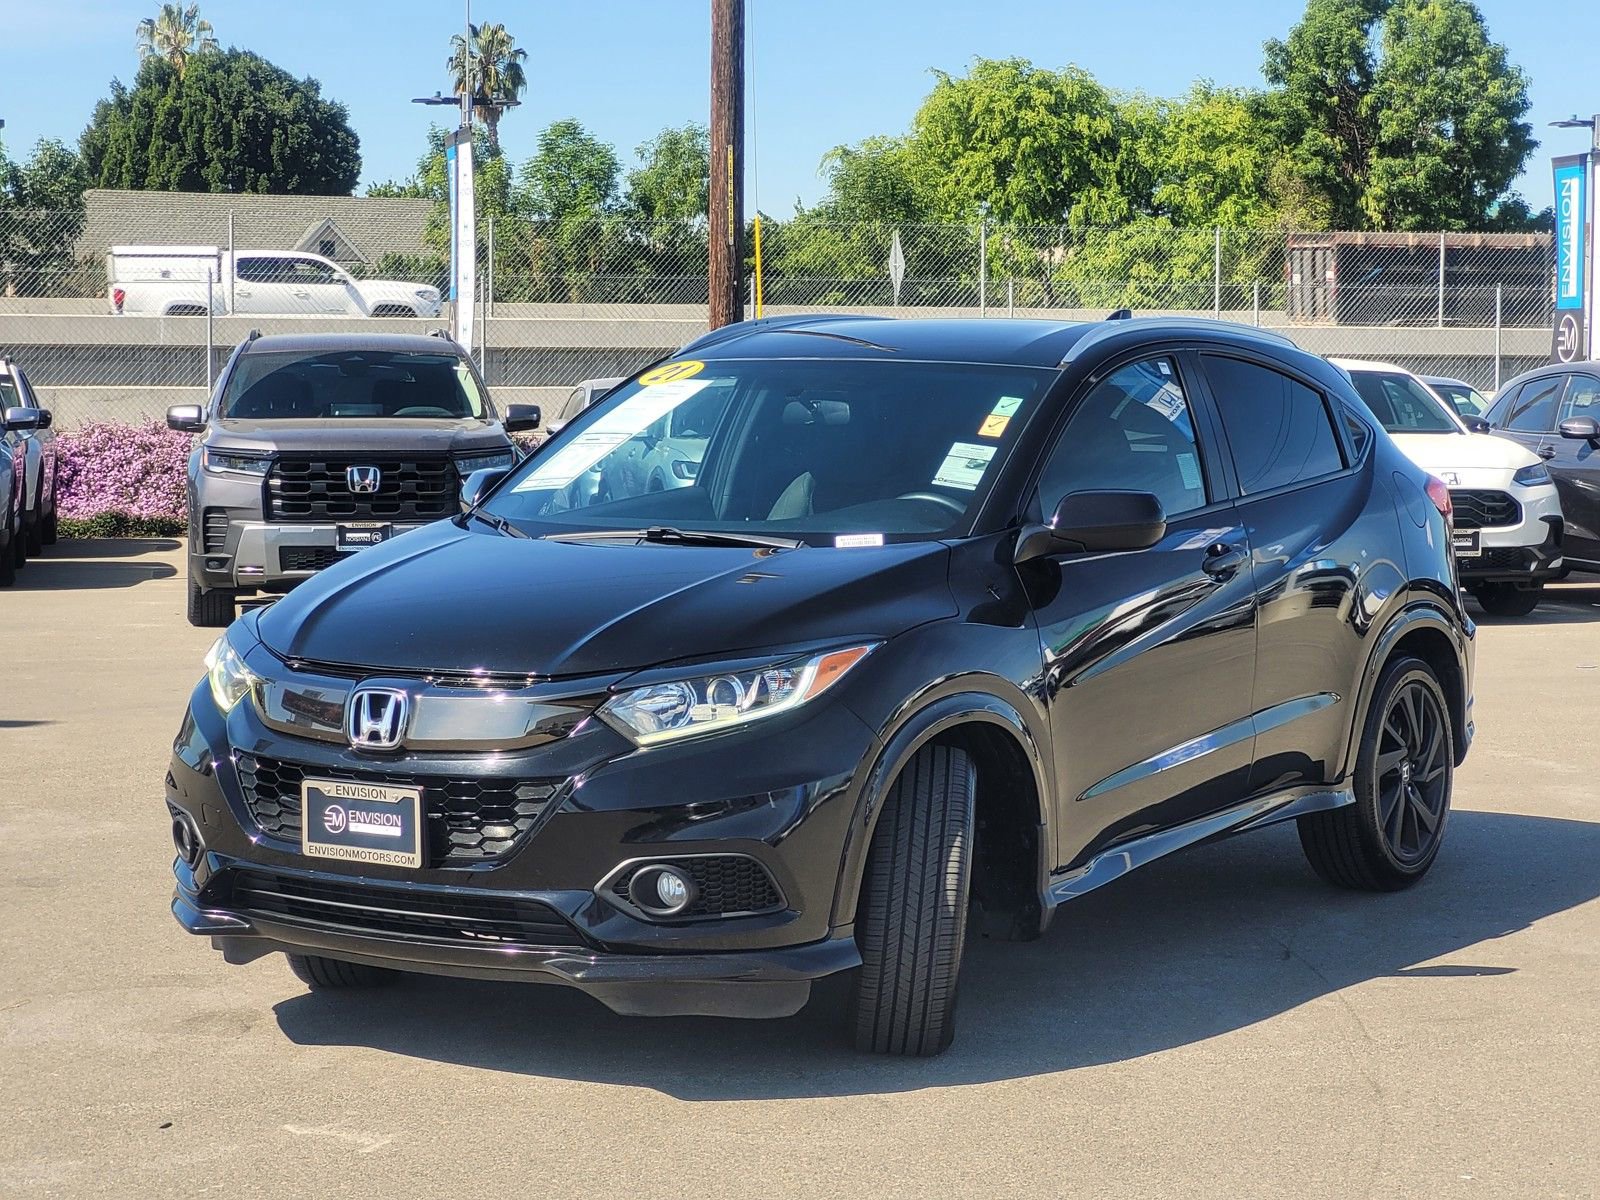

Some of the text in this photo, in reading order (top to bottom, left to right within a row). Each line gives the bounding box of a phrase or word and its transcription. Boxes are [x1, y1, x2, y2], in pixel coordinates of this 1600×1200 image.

[1561, 178, 1572, 298] ENVISION
[335, 785, 387, 800] ENVISION
[348, 810, 402, 827] ENVISION
[308, 845, 416, 866] ENVISIONMOTORS.COM
